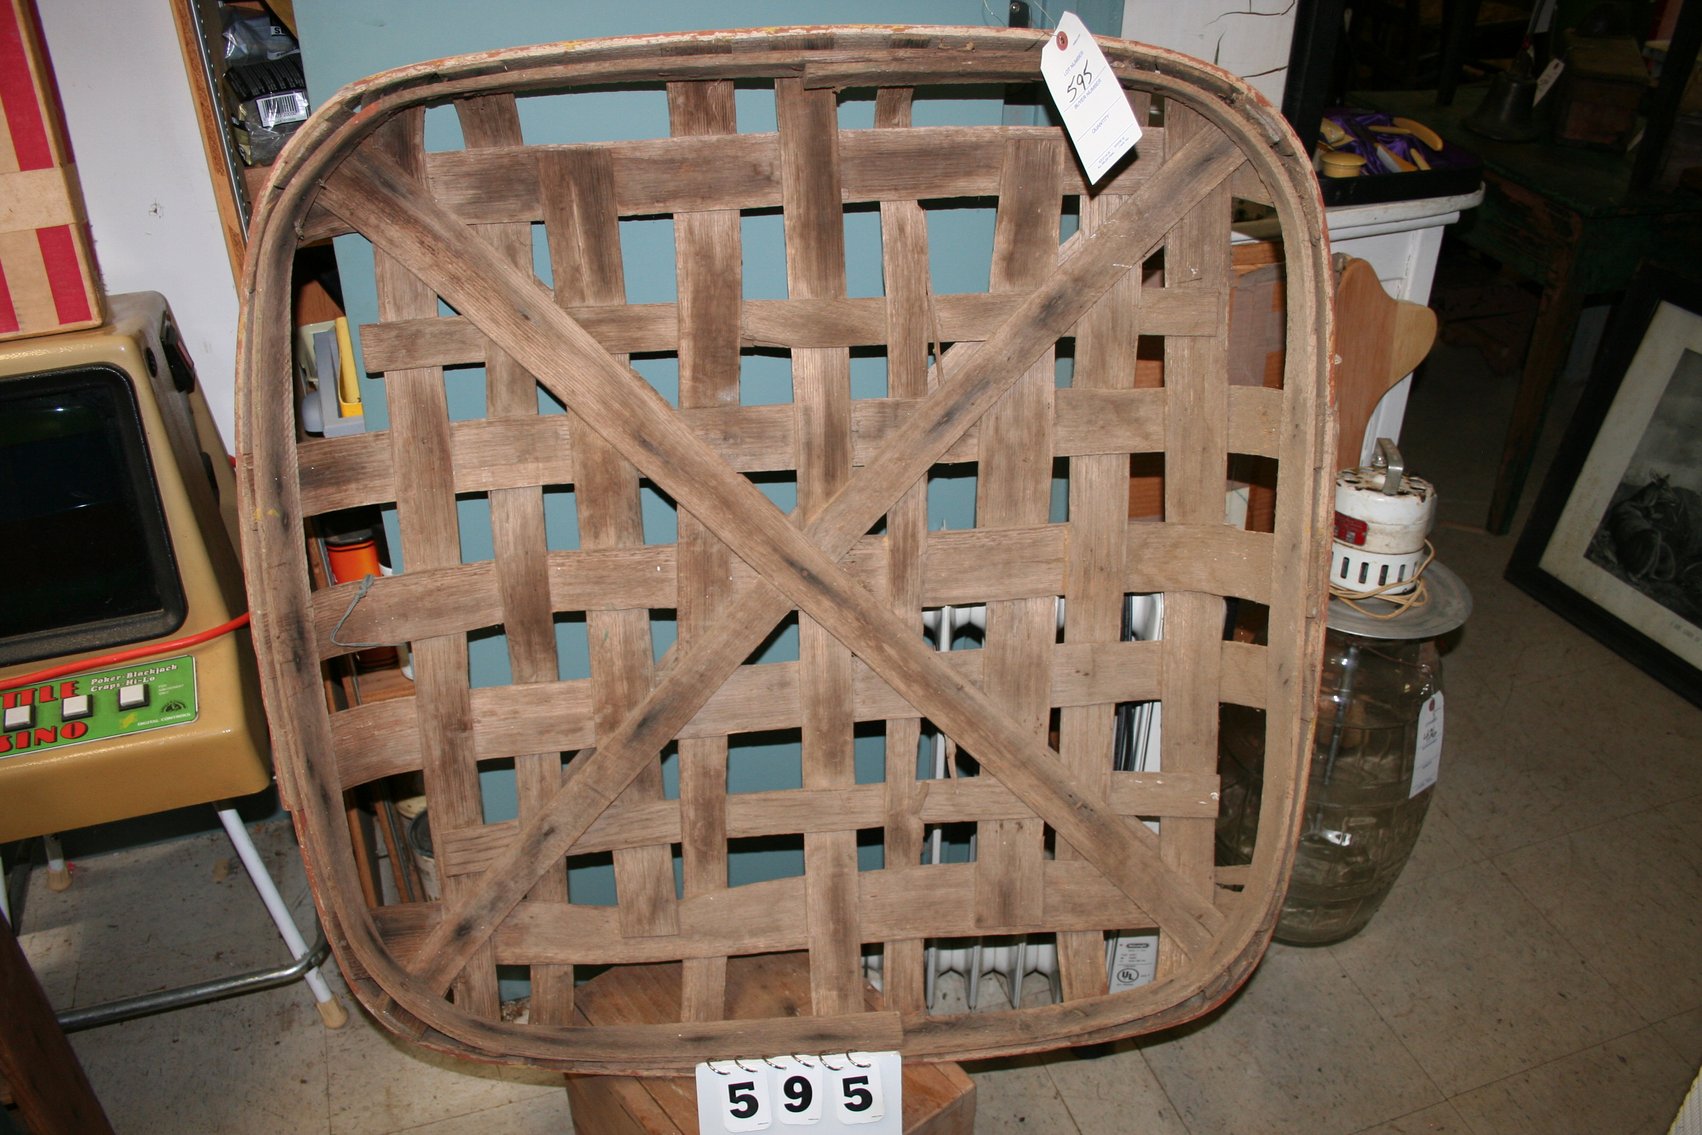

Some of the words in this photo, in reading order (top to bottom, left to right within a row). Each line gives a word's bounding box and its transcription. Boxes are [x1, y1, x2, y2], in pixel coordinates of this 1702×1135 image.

[1067, 59, 1093, 103] 595
[90, 675, 121, 685] Poker
[126, 664, 177, 679] Blackjack
[90, 682, 121, 692] Craps
